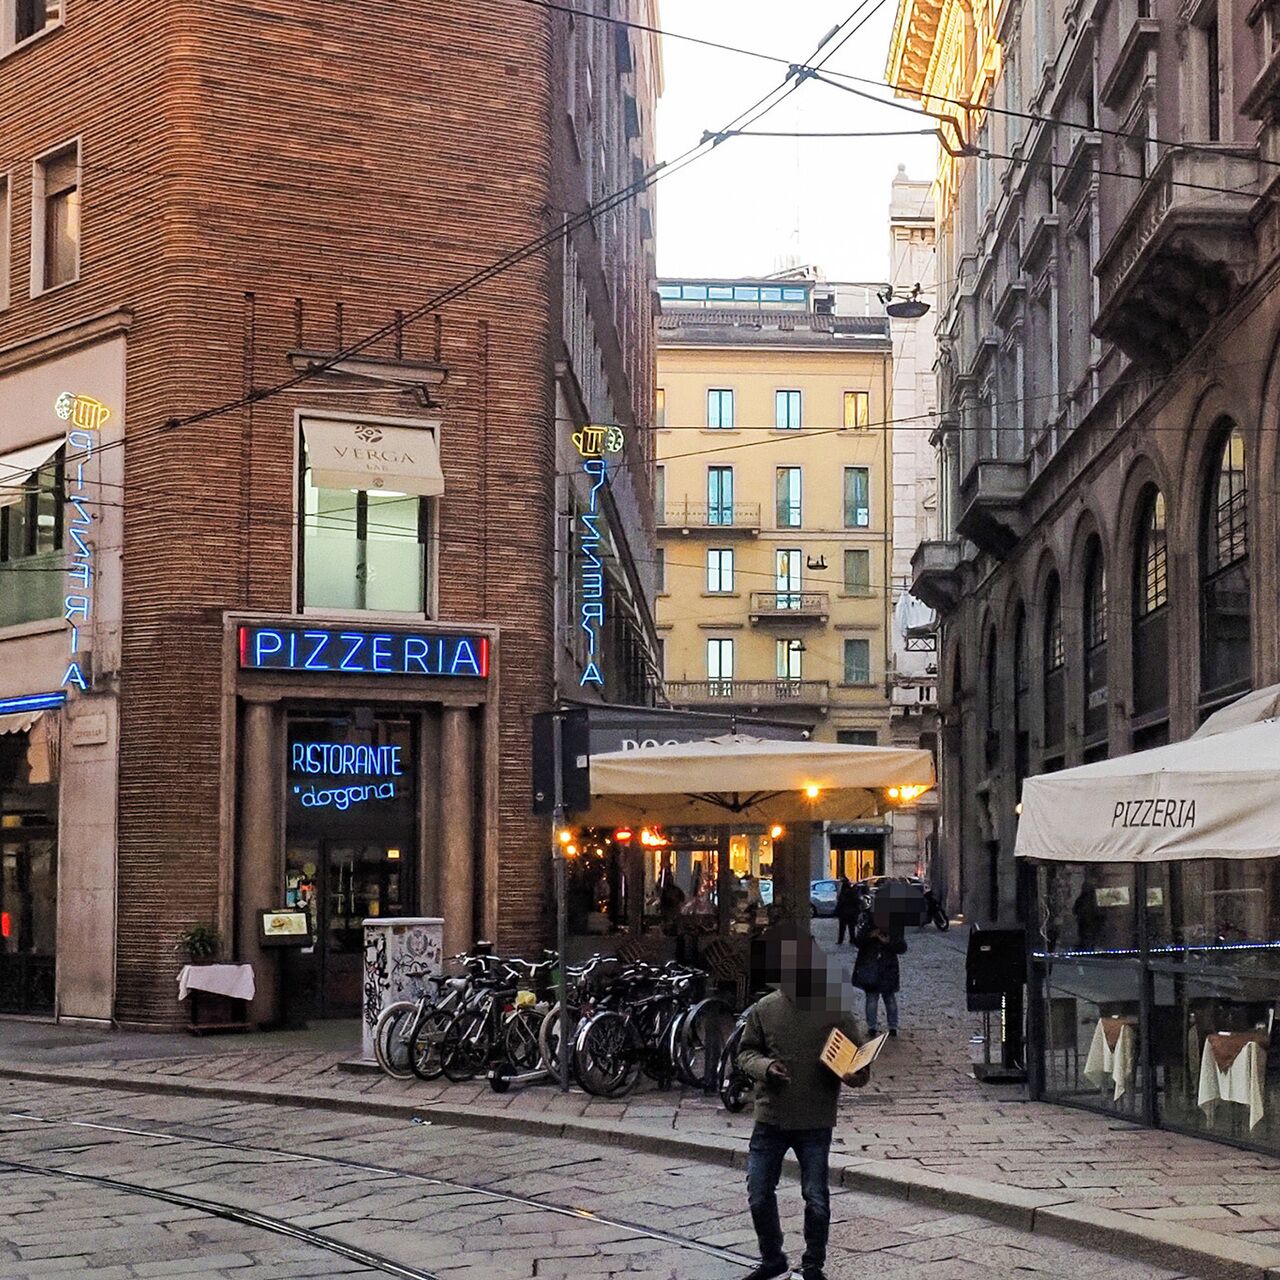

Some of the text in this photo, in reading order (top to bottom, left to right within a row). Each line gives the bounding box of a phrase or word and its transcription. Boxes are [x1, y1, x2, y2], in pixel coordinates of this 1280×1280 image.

[333, 445, 415, 465] VERGA
[255, 631, 480, 675] PIZZERIA
[292, 743, 403, 775] RISTORANTE
[1111, 799, 1196, 827] PIZZERIA
